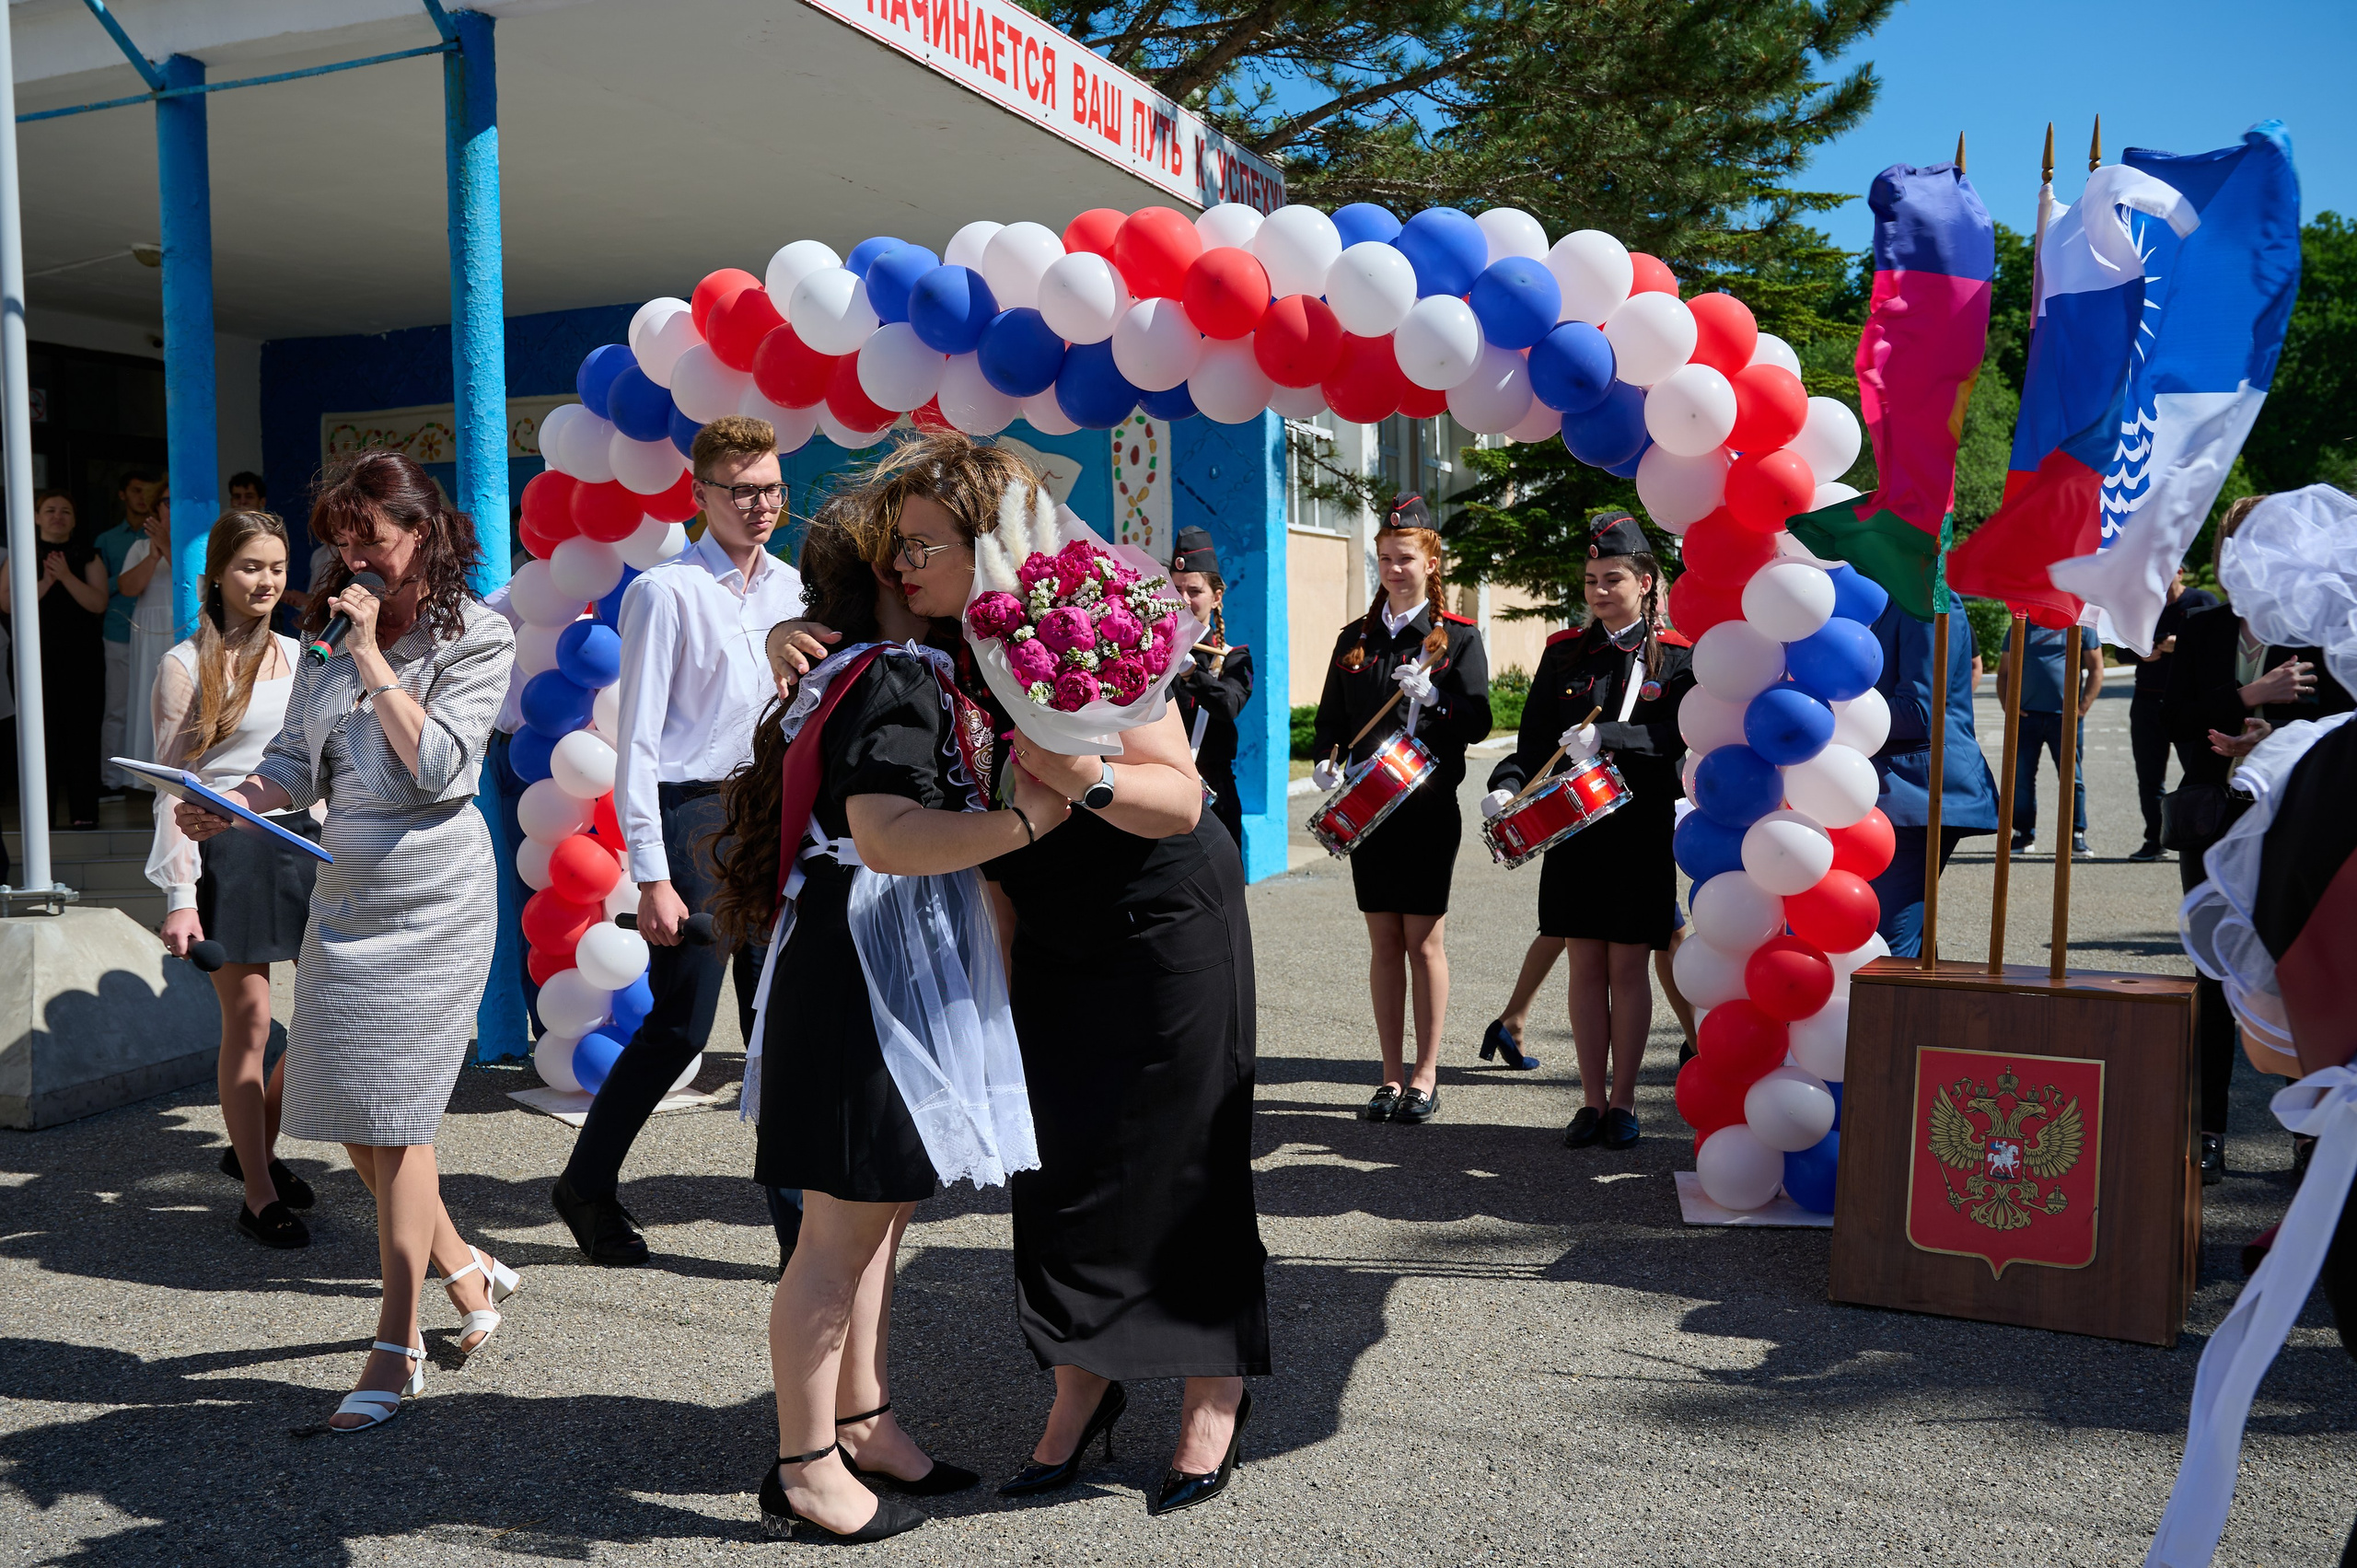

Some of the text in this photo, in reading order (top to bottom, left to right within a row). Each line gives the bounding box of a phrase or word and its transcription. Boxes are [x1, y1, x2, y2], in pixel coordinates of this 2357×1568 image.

[867, 0, 1056, 110] ЧИНАЕТСЯ
[1074, 62, 1121, 146] ВАШ
[1132, 97, 1182, 177] ПУТЬ
[1195, 134, 1205, 192] К
